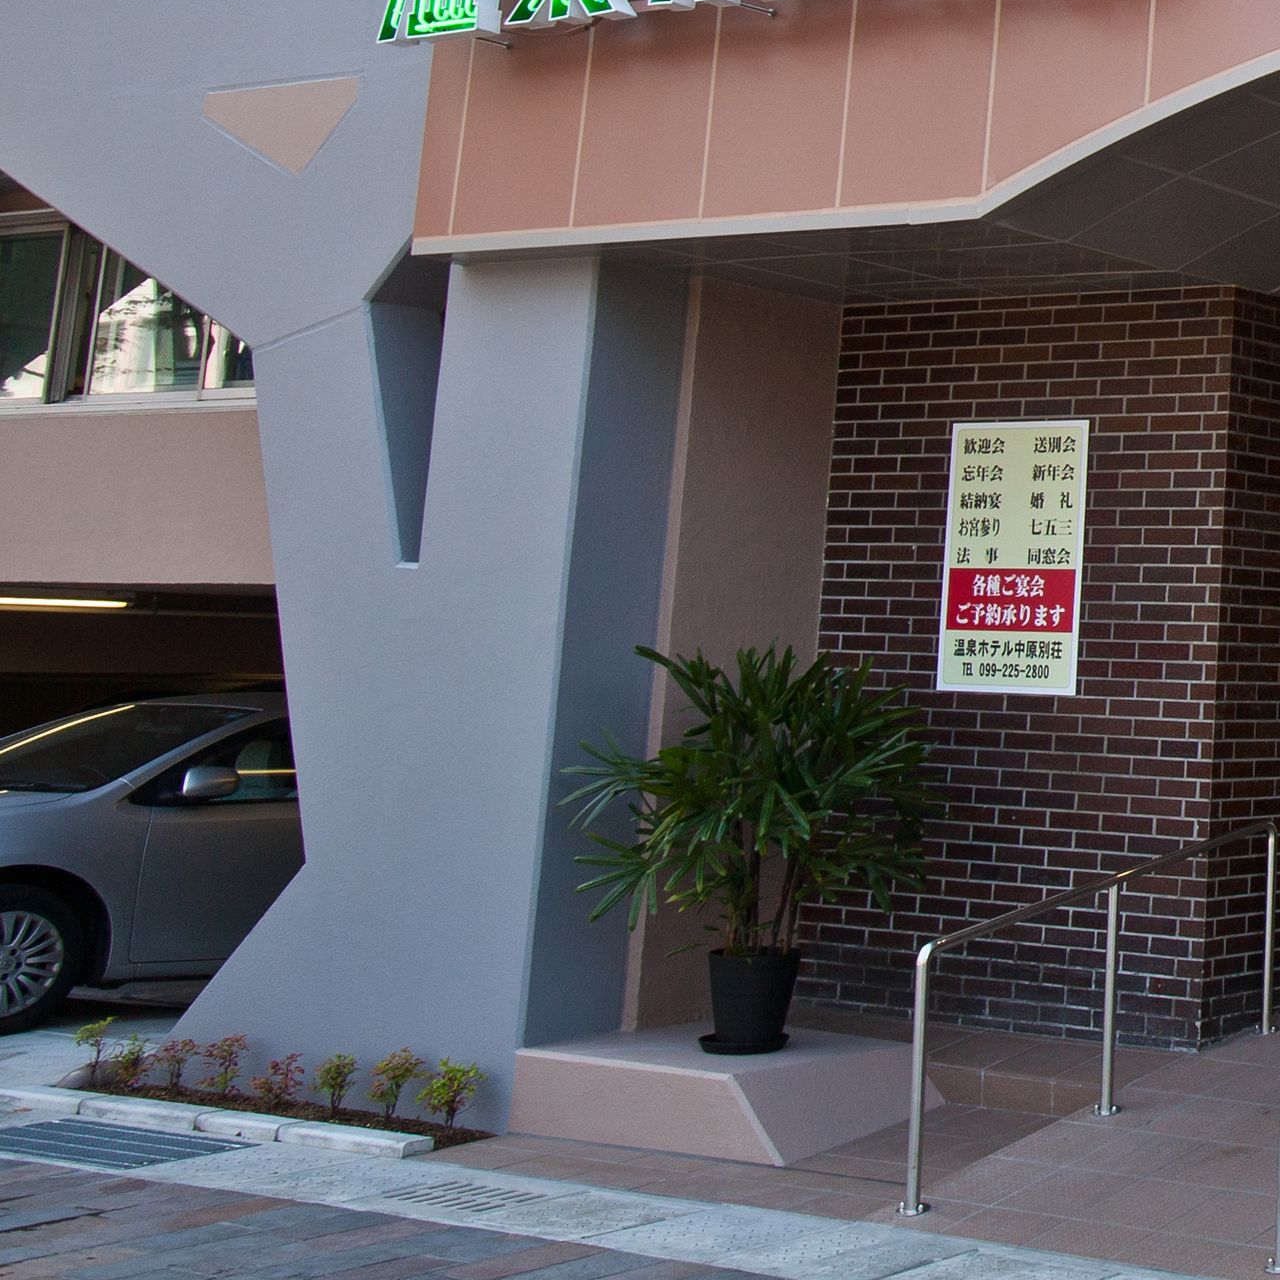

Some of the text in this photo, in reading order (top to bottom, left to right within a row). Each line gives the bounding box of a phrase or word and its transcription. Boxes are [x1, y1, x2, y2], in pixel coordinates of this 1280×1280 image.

[964, 438, 1005, 454] 歓迎会
[1034, 436, 1076, 453] 送別会
[962, 465, 1003, 481] 忘年会
[1033, 464, 1074, 481] 新年会
[961, 492, 1001, 509] 結納宴
[959, 518, 999, 536] お宮参り
[1029, 519, 1072, 535] 七五三
[1028, 548, 1070, 564] 同窓会
[973, 574, 1045, 597] 各種ご宴会
[957, 603, 1065, 626] ご予約承ります
[954, 639, 1062, 659] 温泉ホテル中原別荘
[963, 663, 1049, 678] TEL 099-225-2800
